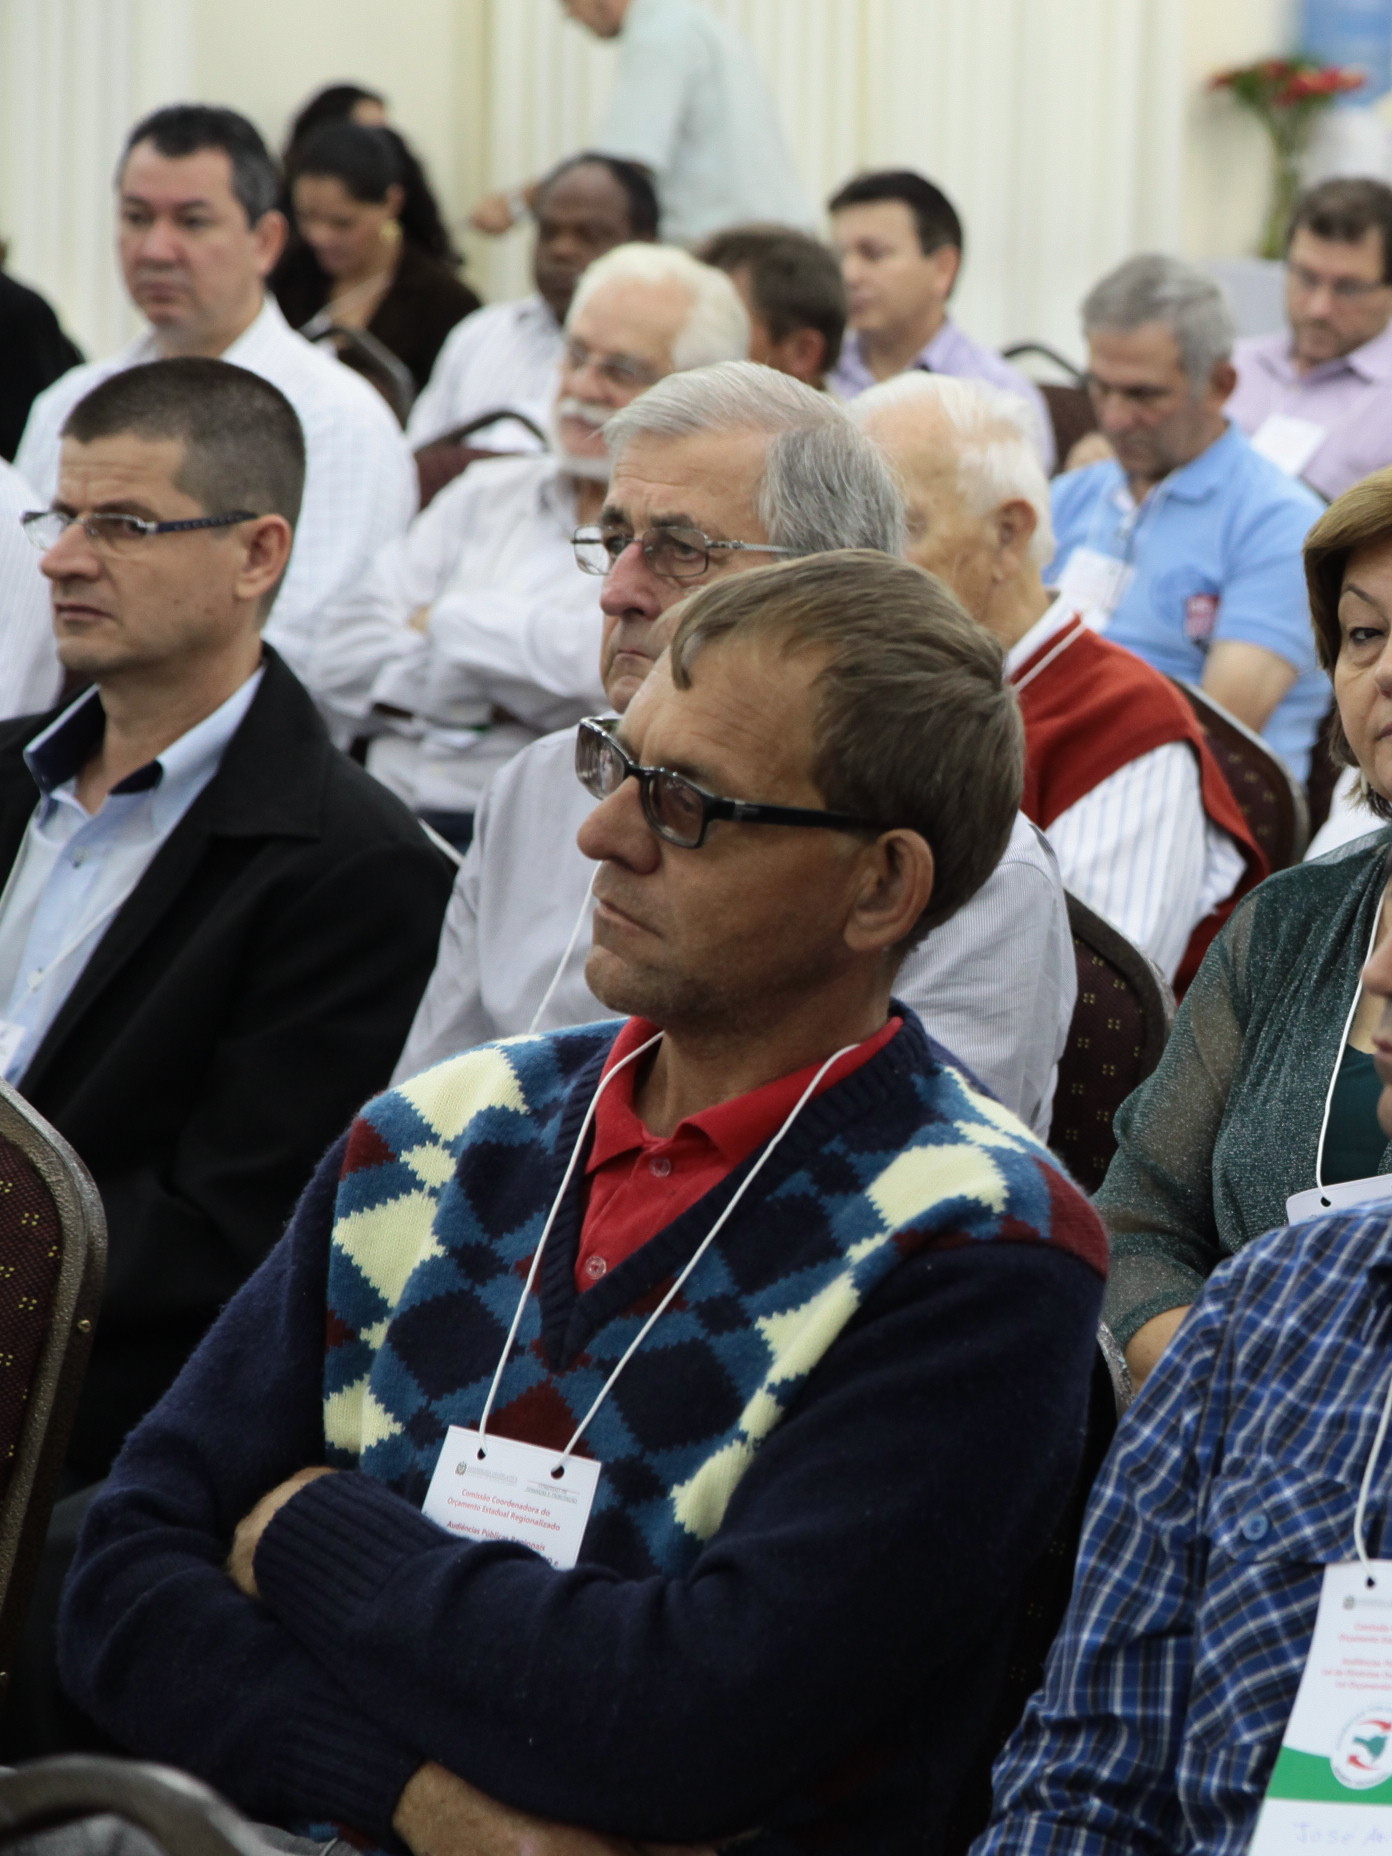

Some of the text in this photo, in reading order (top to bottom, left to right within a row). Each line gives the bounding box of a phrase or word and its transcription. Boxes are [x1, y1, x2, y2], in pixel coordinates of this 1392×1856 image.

[447, 1497, 560, 1531] Orçamento Estadual Regionalizado
[462, 1488, 550, 1517] Comissão Coordenadora do
[447, 1521, 480, 1535] Audiências
